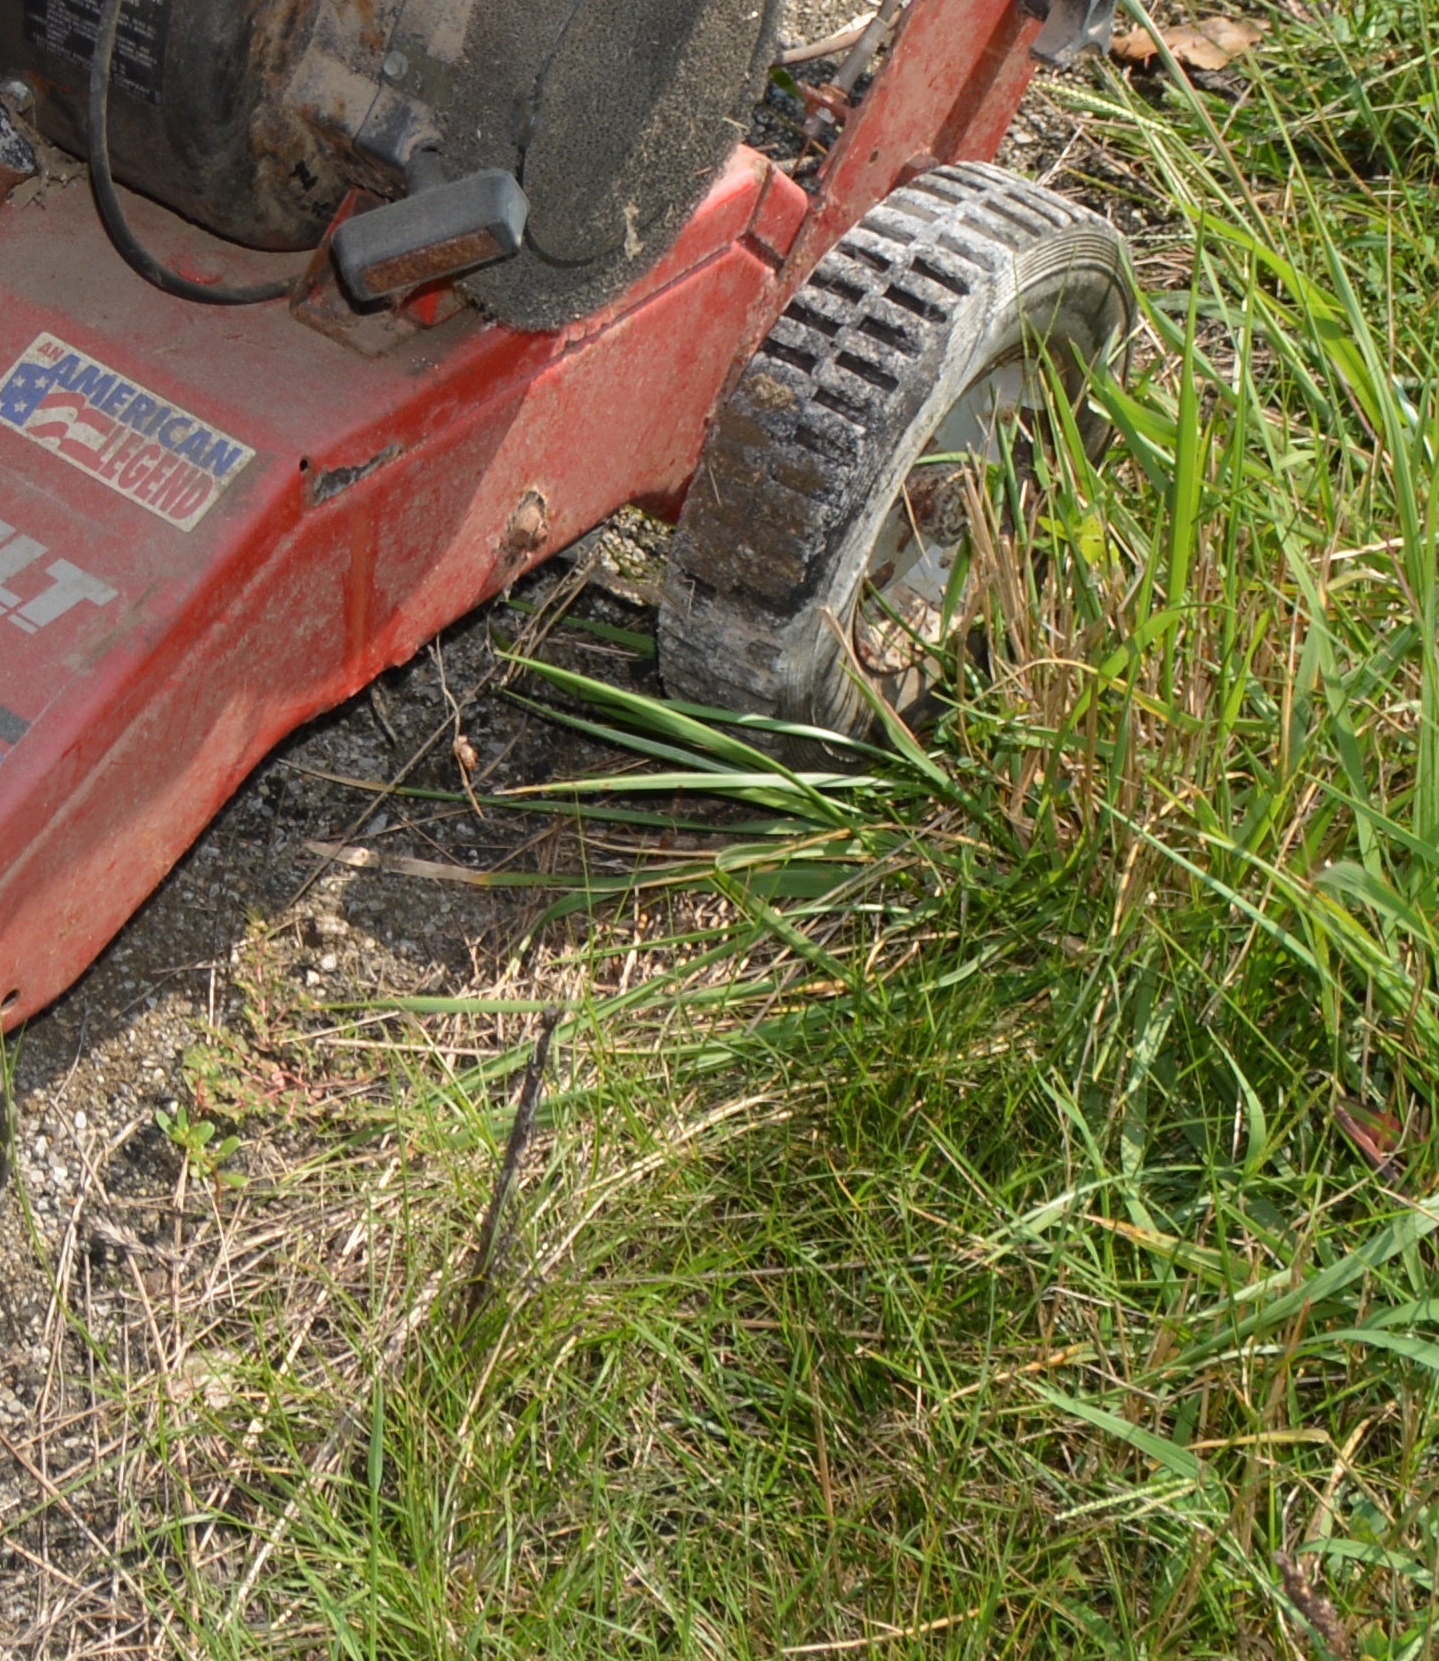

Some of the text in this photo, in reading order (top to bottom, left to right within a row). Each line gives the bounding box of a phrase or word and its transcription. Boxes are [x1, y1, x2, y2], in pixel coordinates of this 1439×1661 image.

[37, 341, 65, 362] AN
[47, 353, 243, 477] AMERICAN
[95, 423, 214, 520] LEGEND
